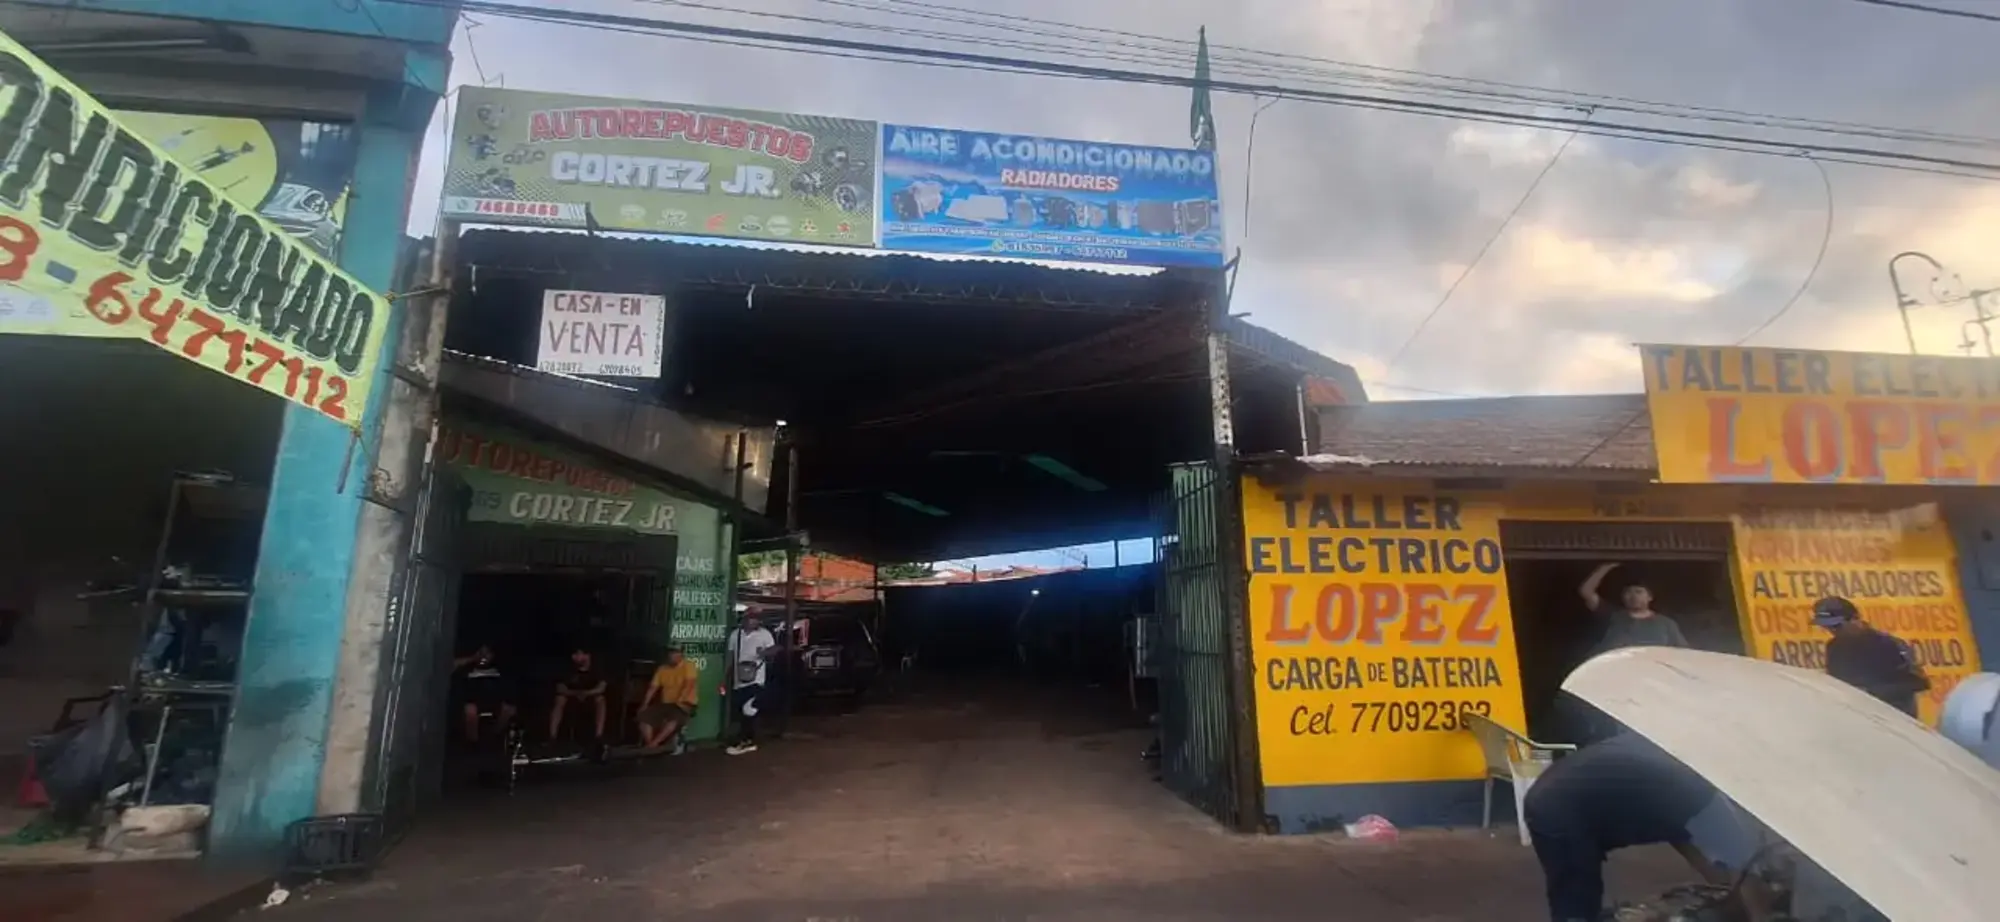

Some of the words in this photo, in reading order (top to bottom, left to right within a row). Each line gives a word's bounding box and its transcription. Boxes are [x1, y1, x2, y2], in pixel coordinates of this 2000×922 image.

[529, 106, 815, 163] AUTOREPUESTOS
[889, 127, 958, 157] AIRE
[971, 136, 1213, 177] ACONDICIONADO
[550, 150, 711, 194] CORTEZ
[720, 163, 782, 199] JR.
[1000, 167, 1120, 193] RADIADORES
[86, 271, 350, 420] 64717112
[548, 320, 644, 357] VENTA
[1648, 347, 1834, 395] TALLER
[509, 491, 635, 527] CORTEZ
[639, 504, 677, 532] JR
[1274, 492, 1462, 530] TALLER
[676, 556, 714, 571] CAJAS
[1250, 536, 1503, 574] ELECTRICO
[673, 589, 722, 606] PALIERES
[1752, 569, 1945, 600] ALTERNADORES
[671, 624, 727, 640] ARRANQUE
[1265, 582, 1500, 646] LOPEZ
[1753, 603, 1960, 635] DISTUIDORES
[1772, 639, 1826, 669] ARRE
[1266, 656, 1364, 691] CARGA
[1367, 661, 1388, 683] DE
[1391, 656, 1503, 689] BATERIA
